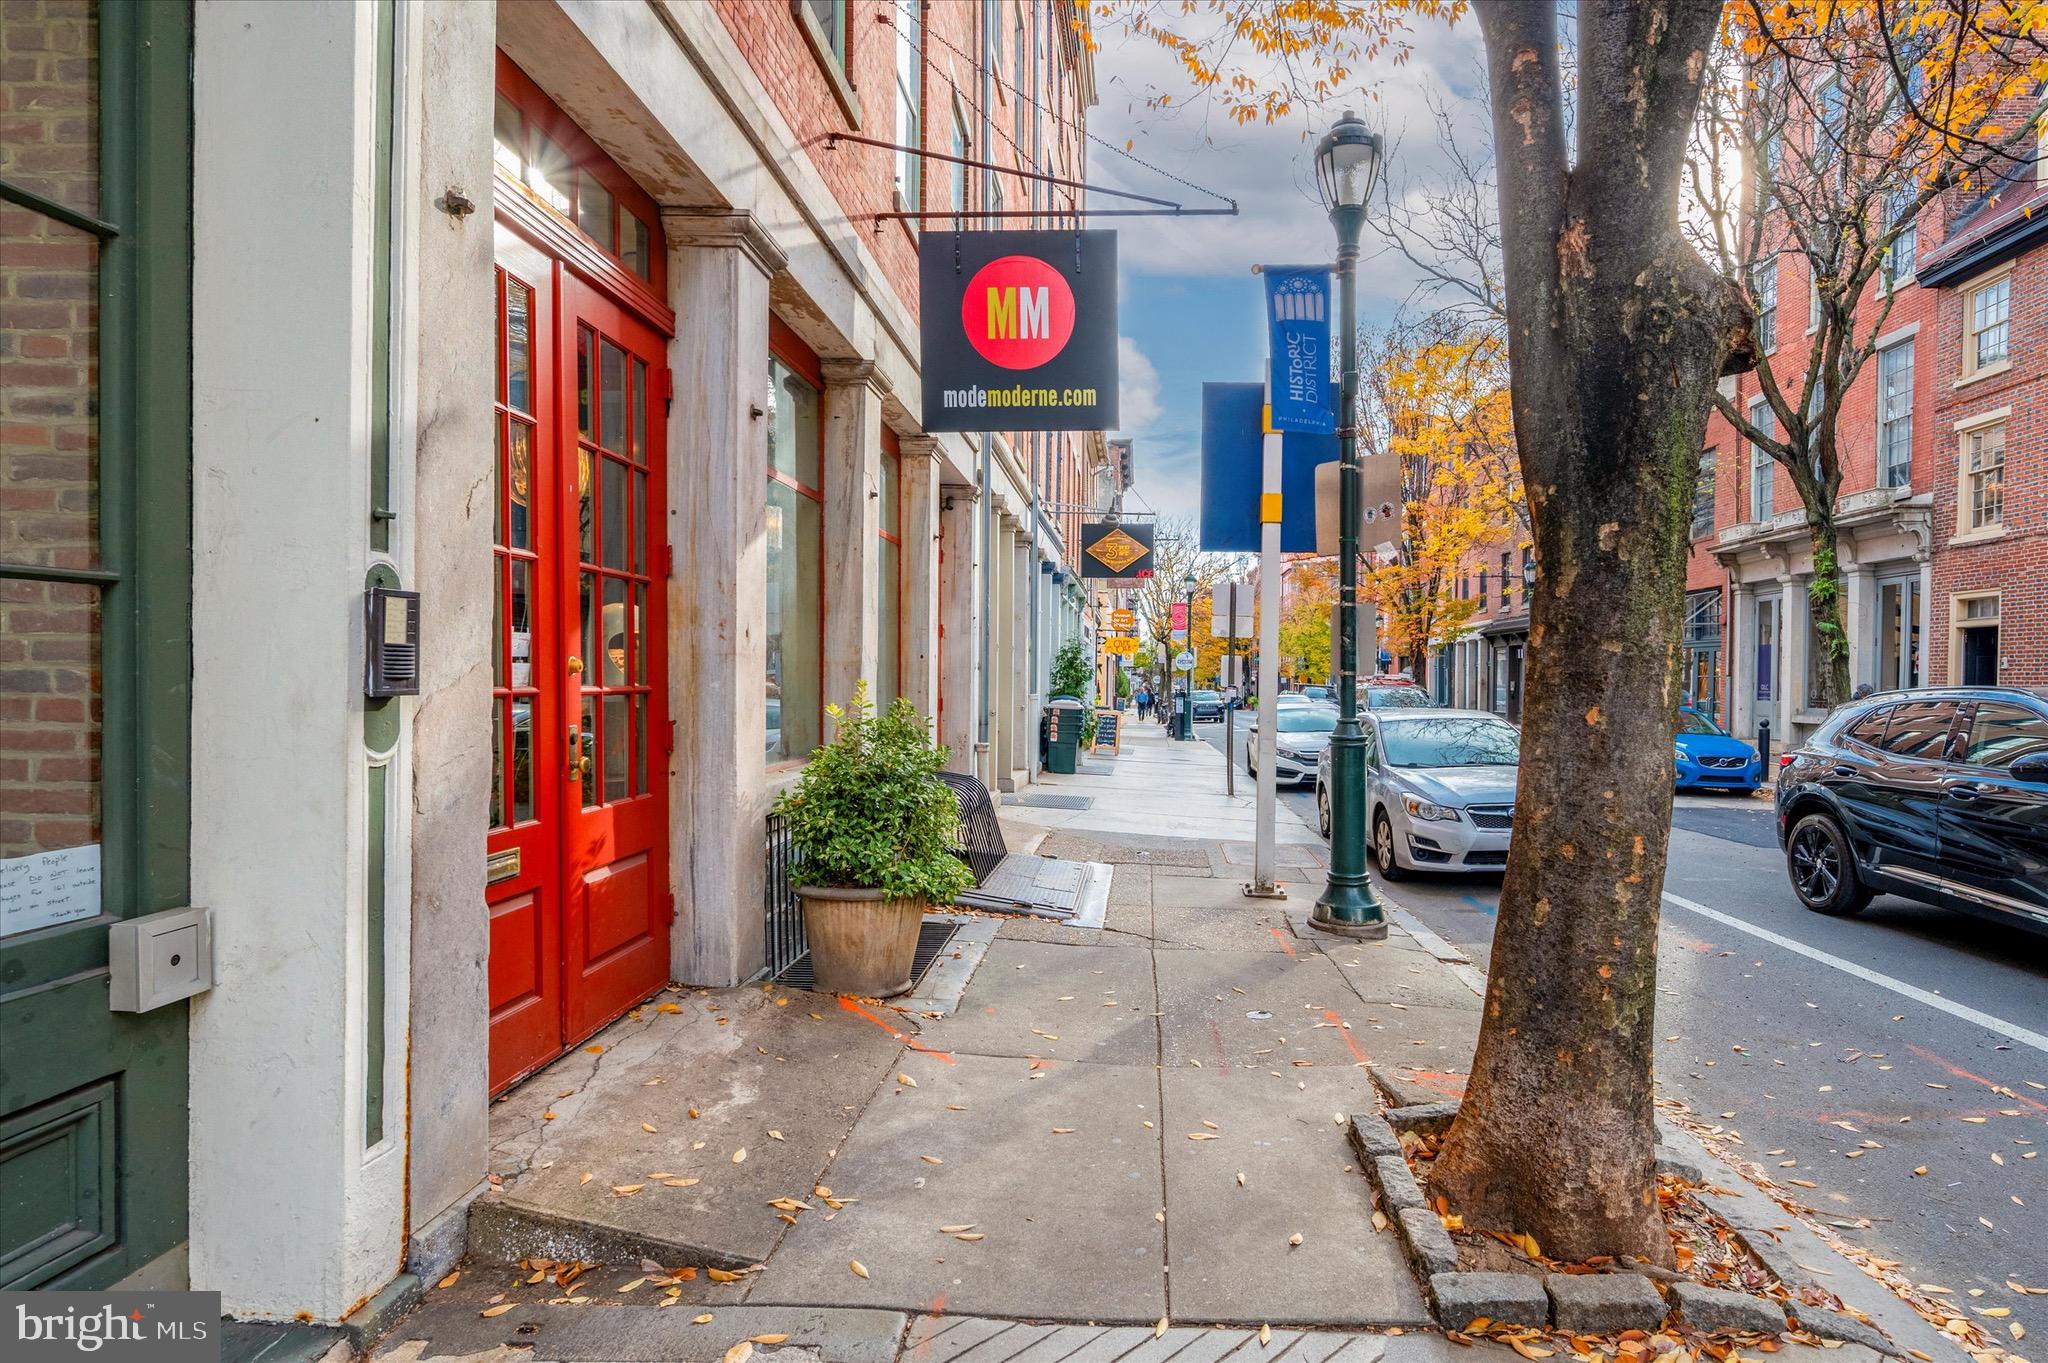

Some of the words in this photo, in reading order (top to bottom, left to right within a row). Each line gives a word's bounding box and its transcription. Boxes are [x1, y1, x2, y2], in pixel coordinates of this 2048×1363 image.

[987, 287, 1049, 340] MM
[1303, 333, 1318, 404] DISTRICT
[944, 384, 1097, 408] modemoderne.com
[1278, 416, 1326, 426] PHILADELPHIA
[1136, 570, 1154, 578] ACE
